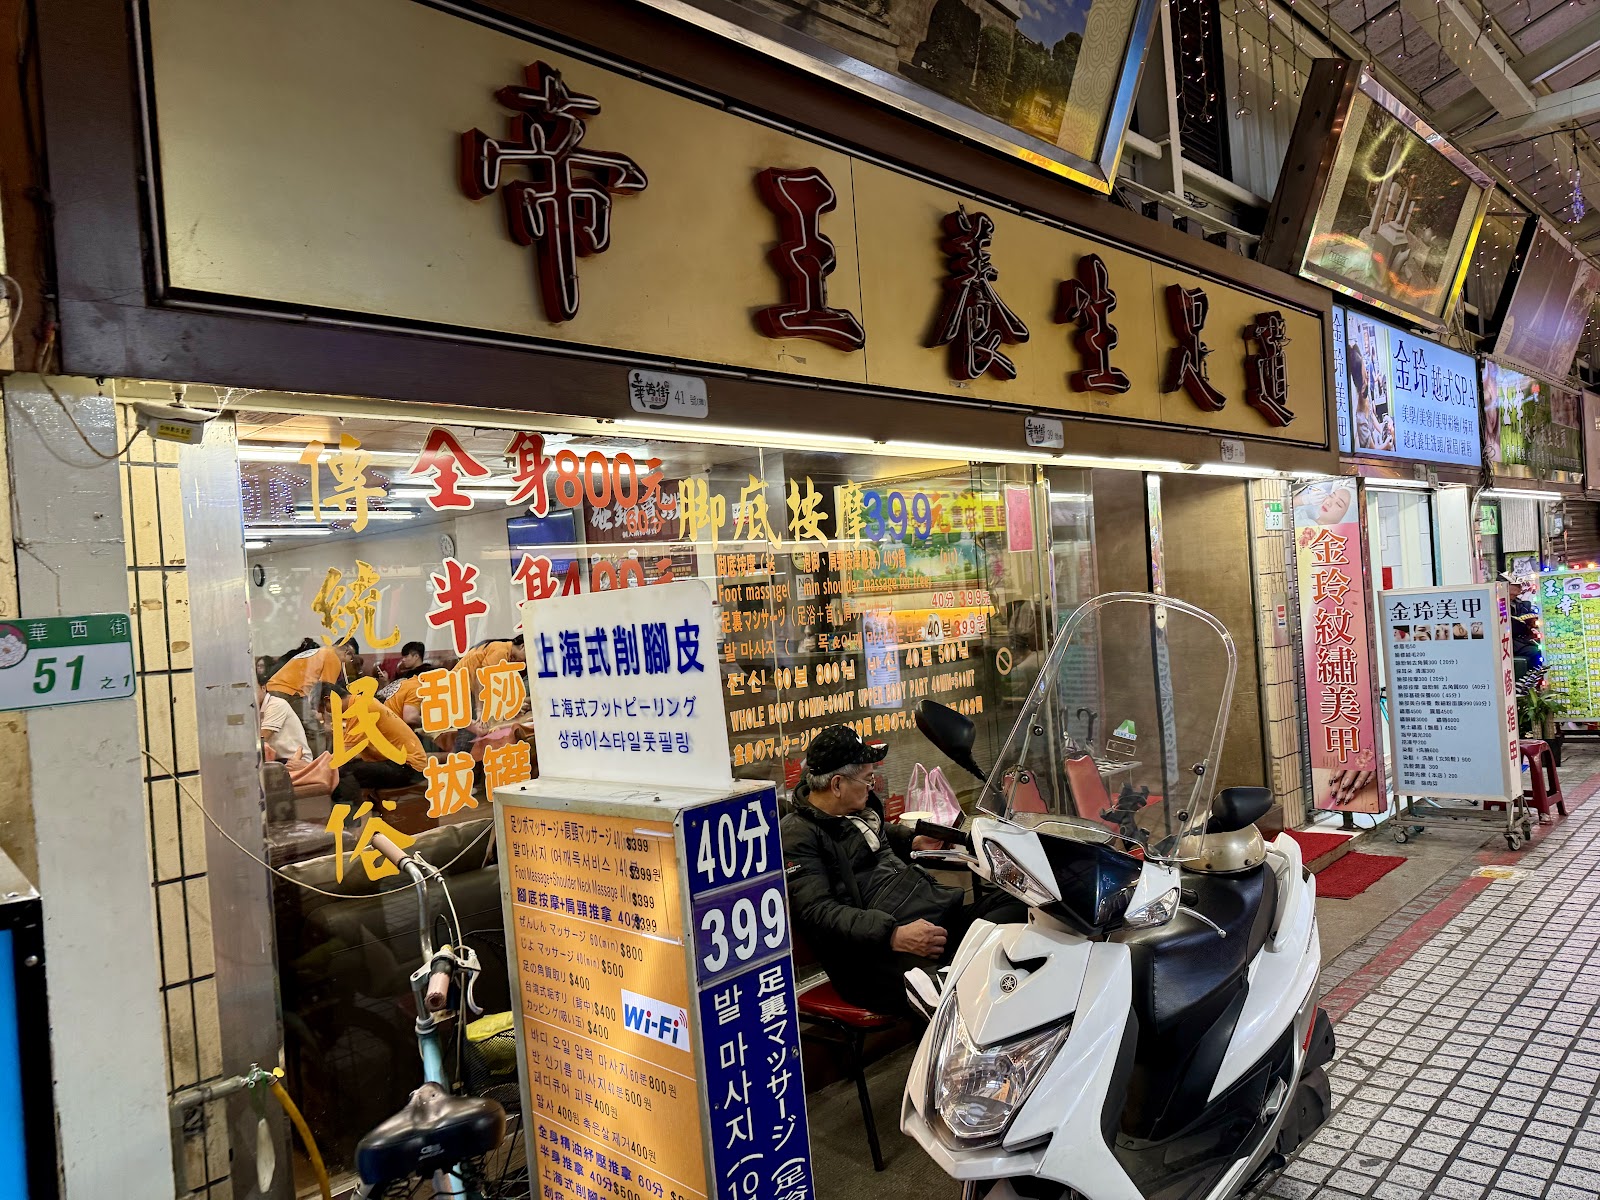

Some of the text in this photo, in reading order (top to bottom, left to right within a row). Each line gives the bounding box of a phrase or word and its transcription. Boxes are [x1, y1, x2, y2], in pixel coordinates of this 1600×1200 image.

[674, 391, 686, 405] 41
[718, 584, 743, 603] Foot
[1389, 598, 1481, 622] 金玲美甲
[28, 617, 128, 641] 華西街
[1309, 527, 1360, 763] 金玲紋繡美甲
[537, 619, 705, 679] 上海式削腳皮
[33, 655, 85, 694] 51
[416, 661, 527, 733] 刮痧
[549, 695, 698, 718] 上海式フットピーリング
[730, 706, 765, 733] WHOLE
[768, 700, 795, 726] BODY
[858, 685, 884, 708] UPPER
[909, 677, 929, 699] PART
[558, 729, 690, 754] 상하이스타일풋필링
[697, 800, 770, 884] 40分
[701, 888, 786, 973] 399
[569, 972, 590, 991] $400
[587, 1020, 609, 1040] $400
[624, 1003, 680, 1045] Wi-Fi
